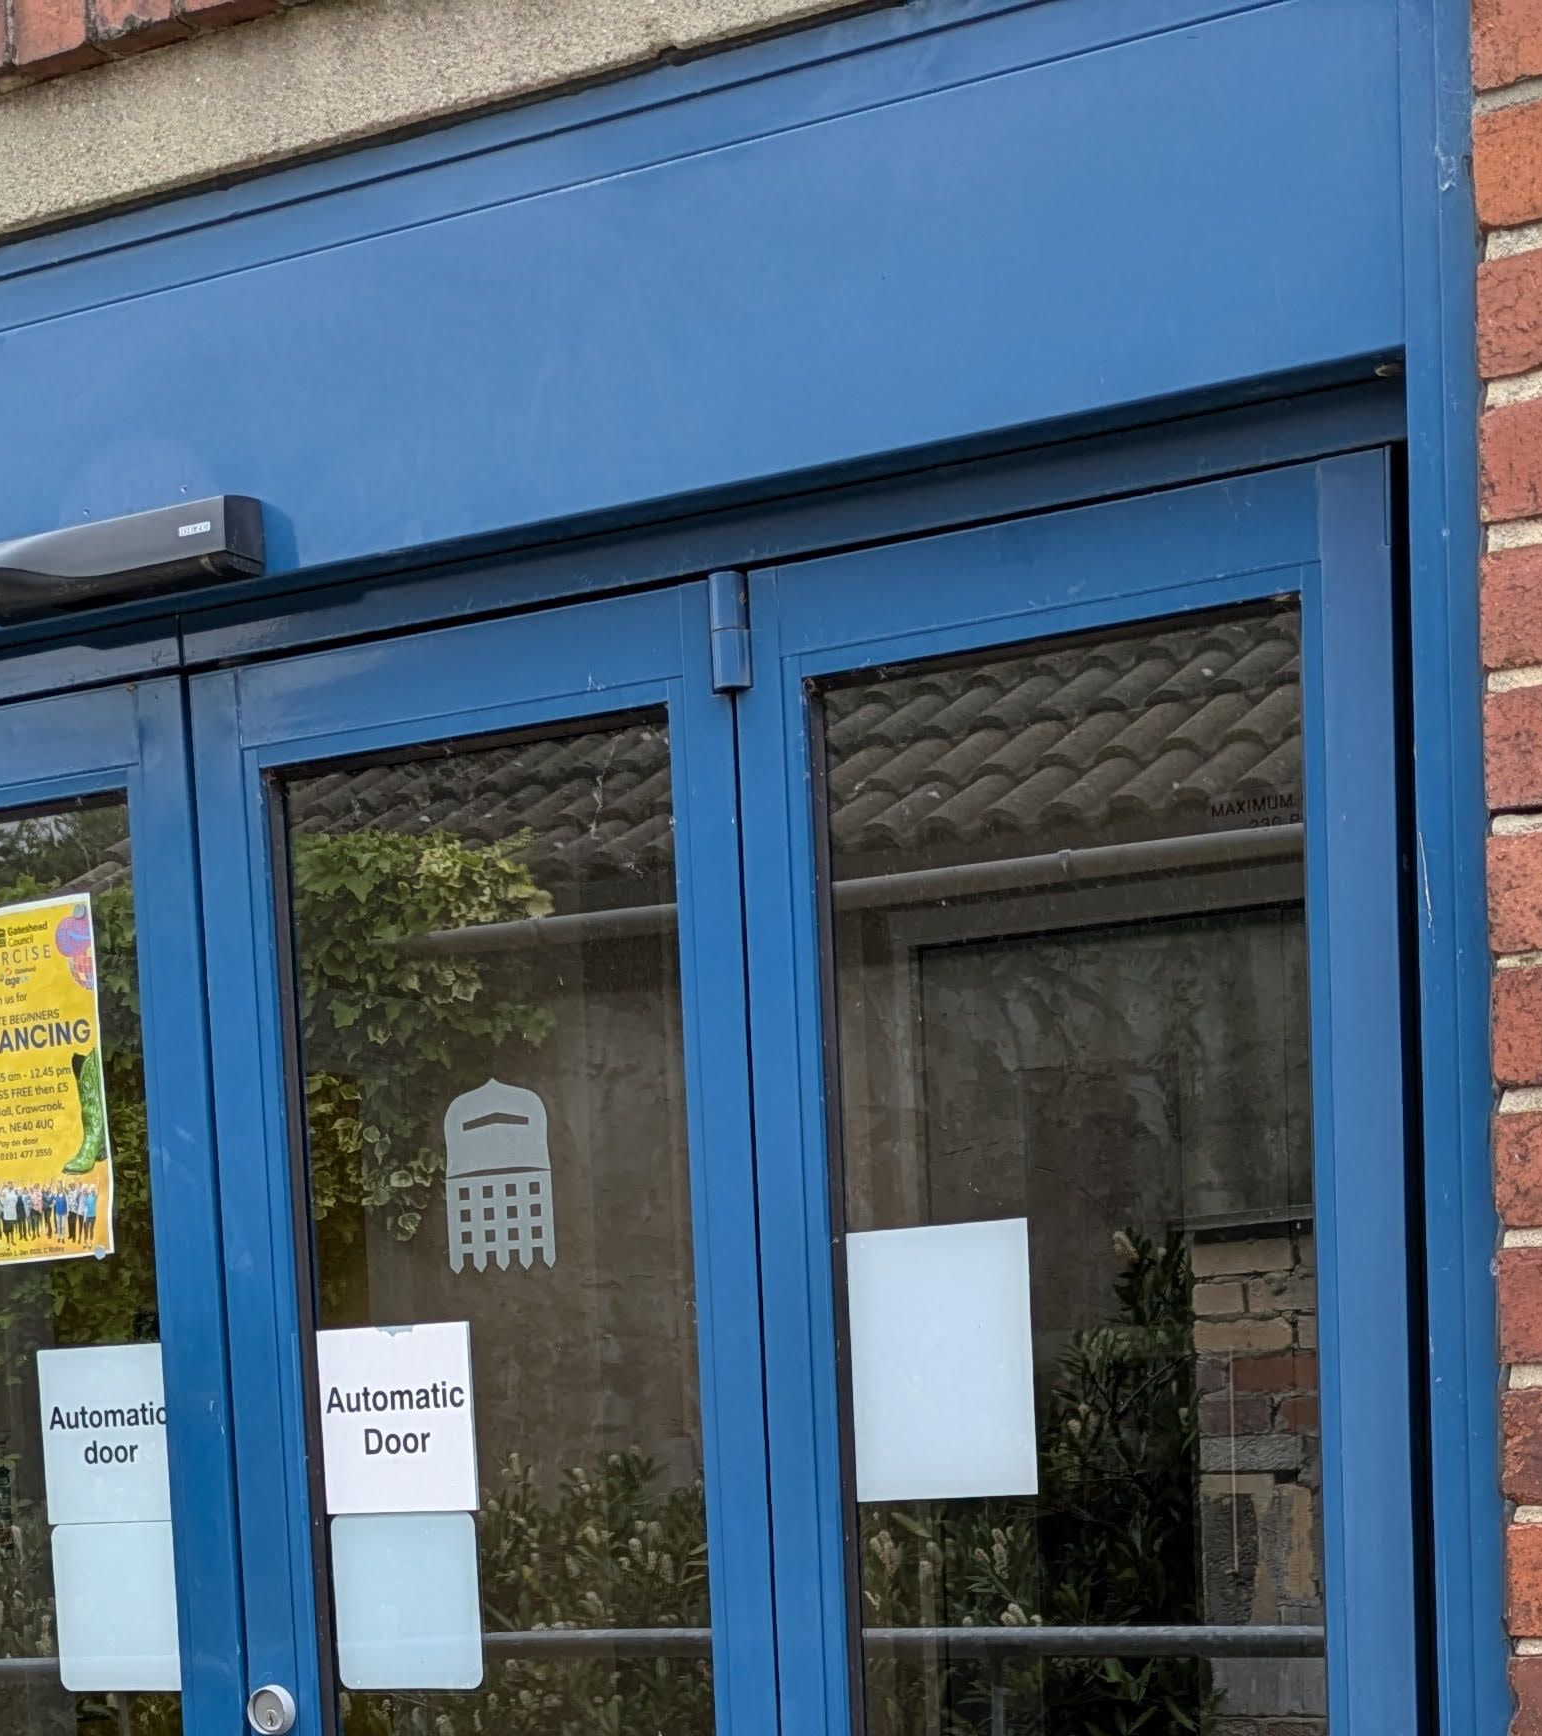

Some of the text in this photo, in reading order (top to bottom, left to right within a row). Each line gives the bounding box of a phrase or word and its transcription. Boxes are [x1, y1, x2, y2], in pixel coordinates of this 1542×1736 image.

[1211, 793, 1293, 818] MAXIMUM
[7, 921, 48, 936] Gateshead
[8, 935, 34, 948] Council
[5, 996, 15, 1004] us
[15, 992, 27, 1003] for
[9, 1009, 60, 1025] BEGINNERS
[7, 1072, 21, 1082] am
[30, 1067, 54, 1080] 12.45
[56, 1067, 71, 1078] pm
[11, 1086, 33, 1098] FREE
[35, 1085, 55, 1096] then
[57, 1082, 69, 1093] £5
[9, 1121, 34, 1133] NE40
[35, 1118, 54, 1130] 4UQ
[11, 1139, 21, 1147] on
[22, 1137, 39, 1145] door
[19, 1149, 34, 1159] 477
[326, 1381, 465, 1415] Automatic
[49, 1403, 167, 1431] Automatic
[363, 1428, 431, 1456] Door
[83, 1440, 139, 1465] door
